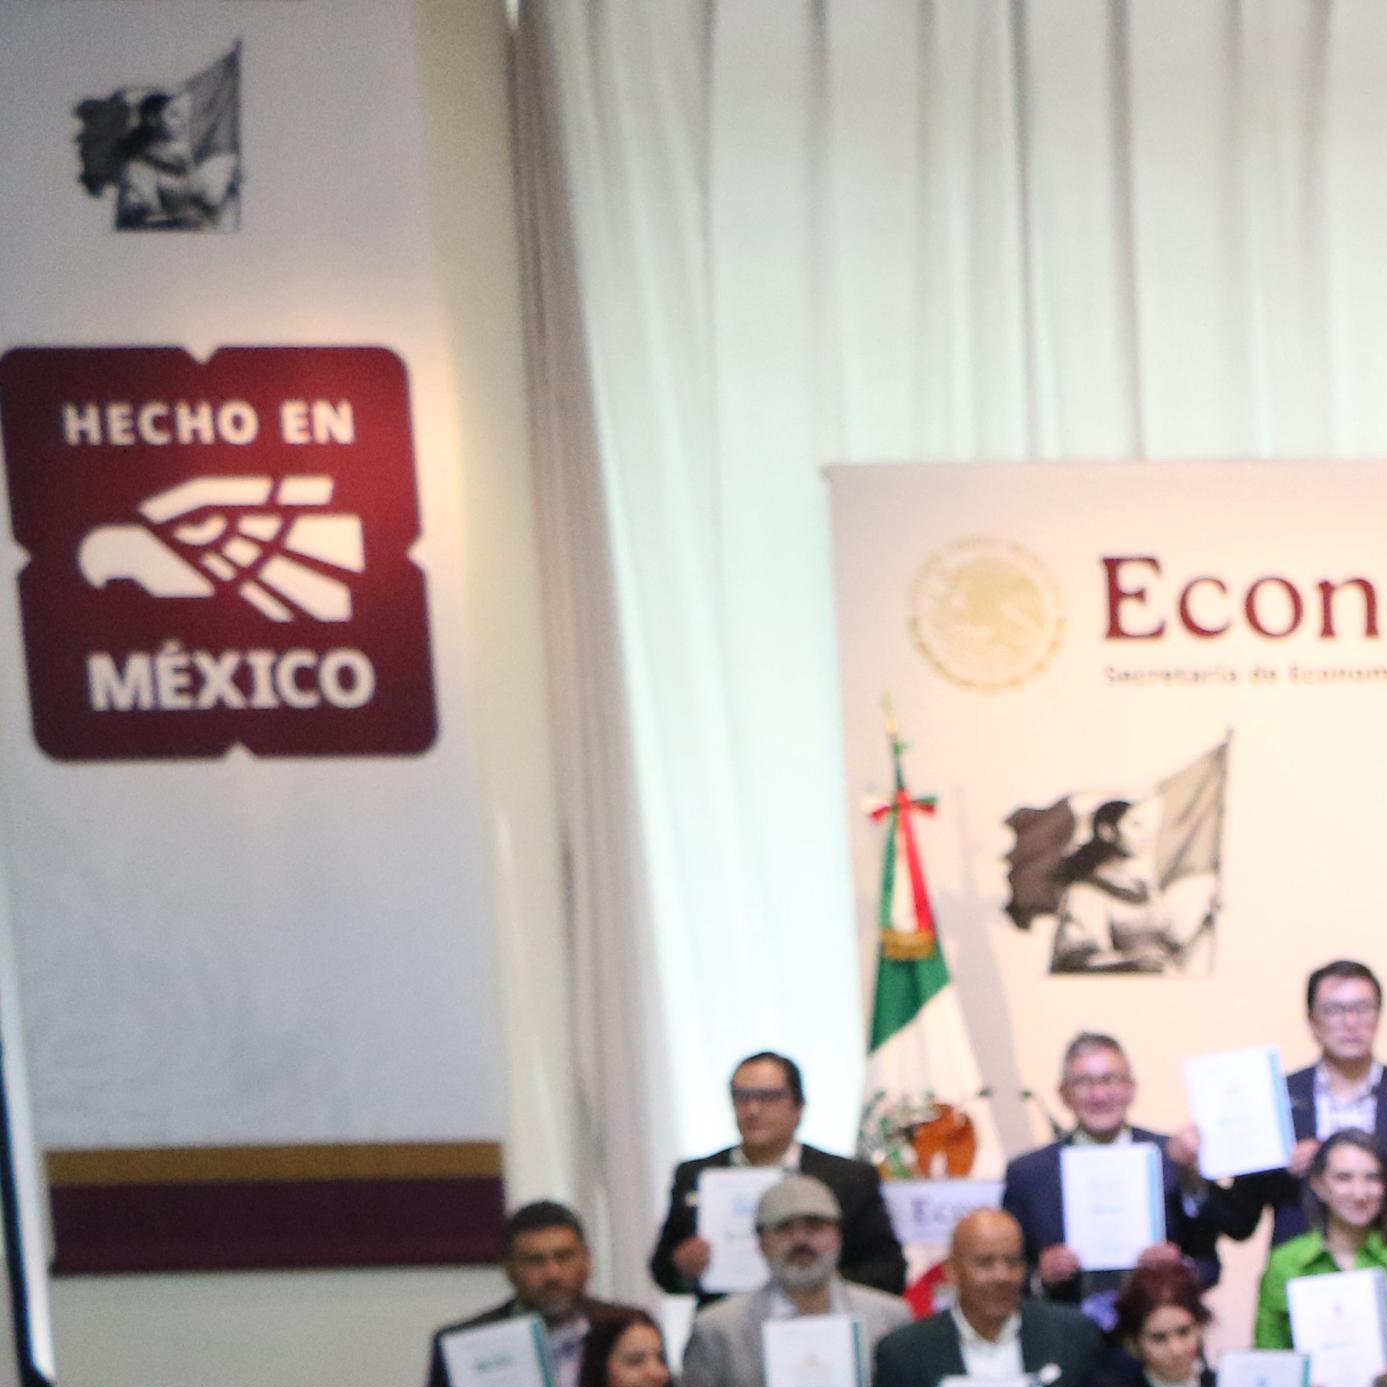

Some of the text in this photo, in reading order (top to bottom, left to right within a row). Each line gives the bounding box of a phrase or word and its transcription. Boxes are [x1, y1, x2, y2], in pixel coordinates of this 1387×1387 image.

[62, 399, 356, 446] HECHO EN
[86, 637, 376, 712] MÉXICO
